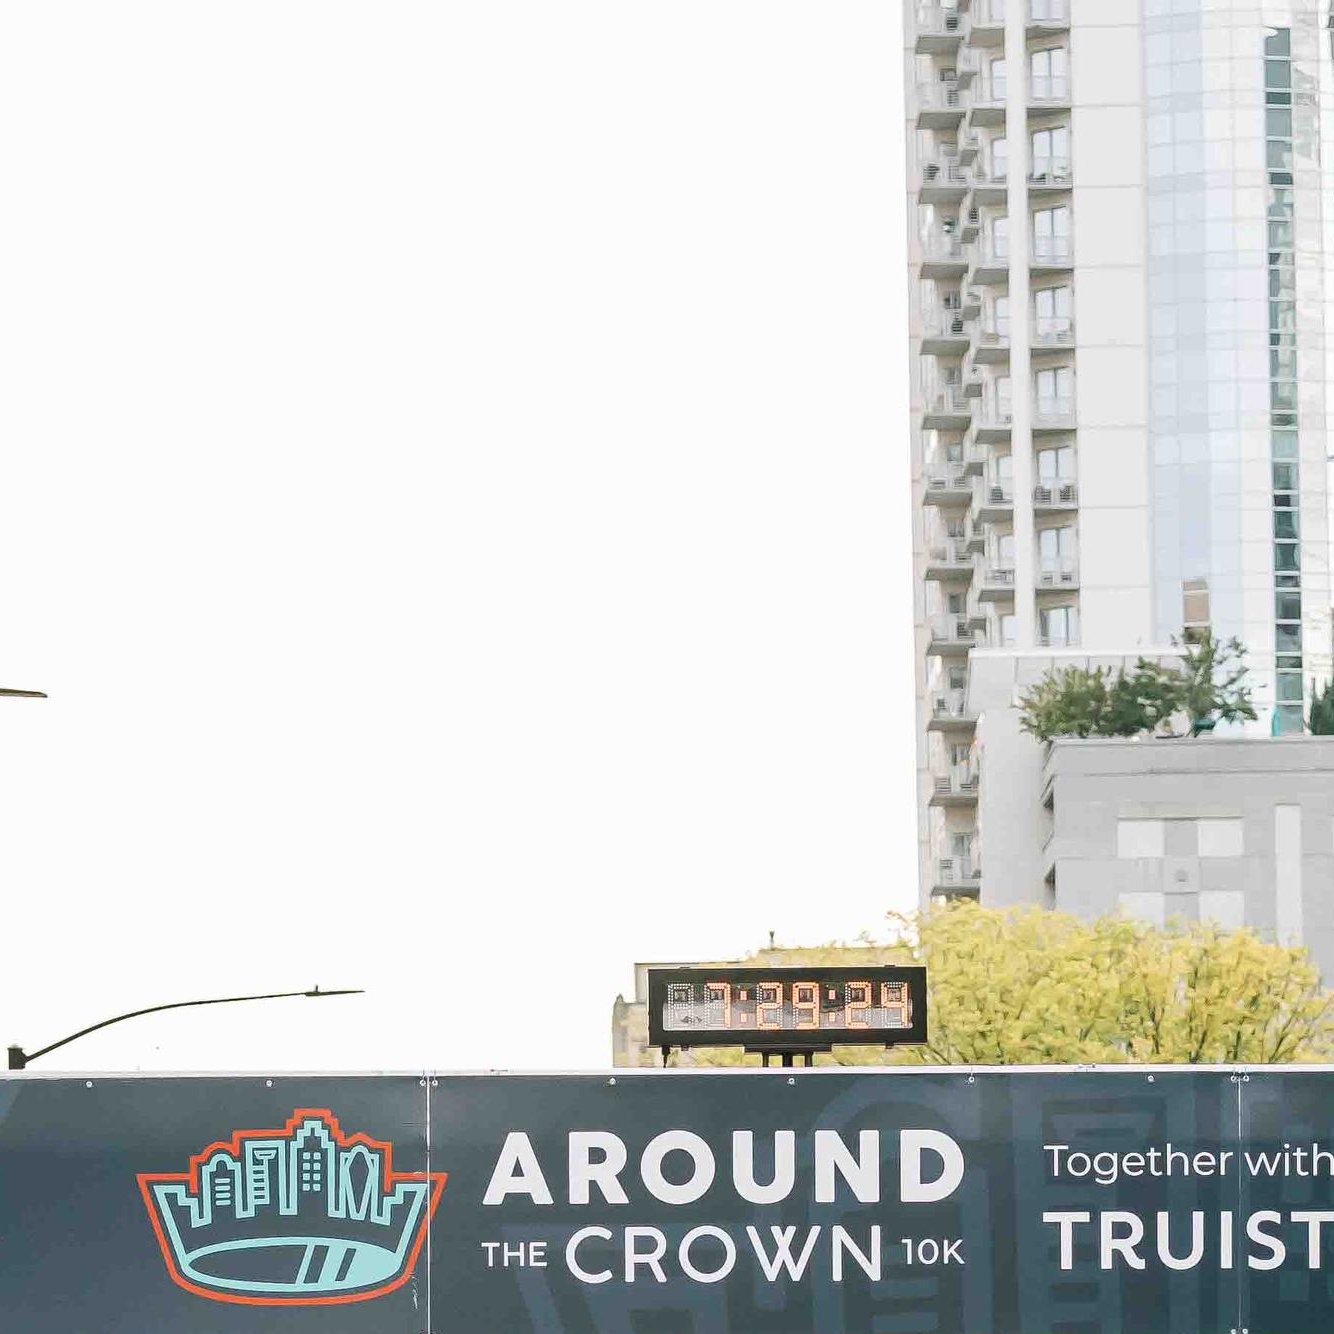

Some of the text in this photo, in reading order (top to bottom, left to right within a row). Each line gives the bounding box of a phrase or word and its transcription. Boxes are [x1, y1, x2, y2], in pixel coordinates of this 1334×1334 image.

[482, 1130, 967, 1206] AROUND
[1043, 1143, 1234, 1185] Together
[482, 1224, 966, 1284] THE CROWN 10K
